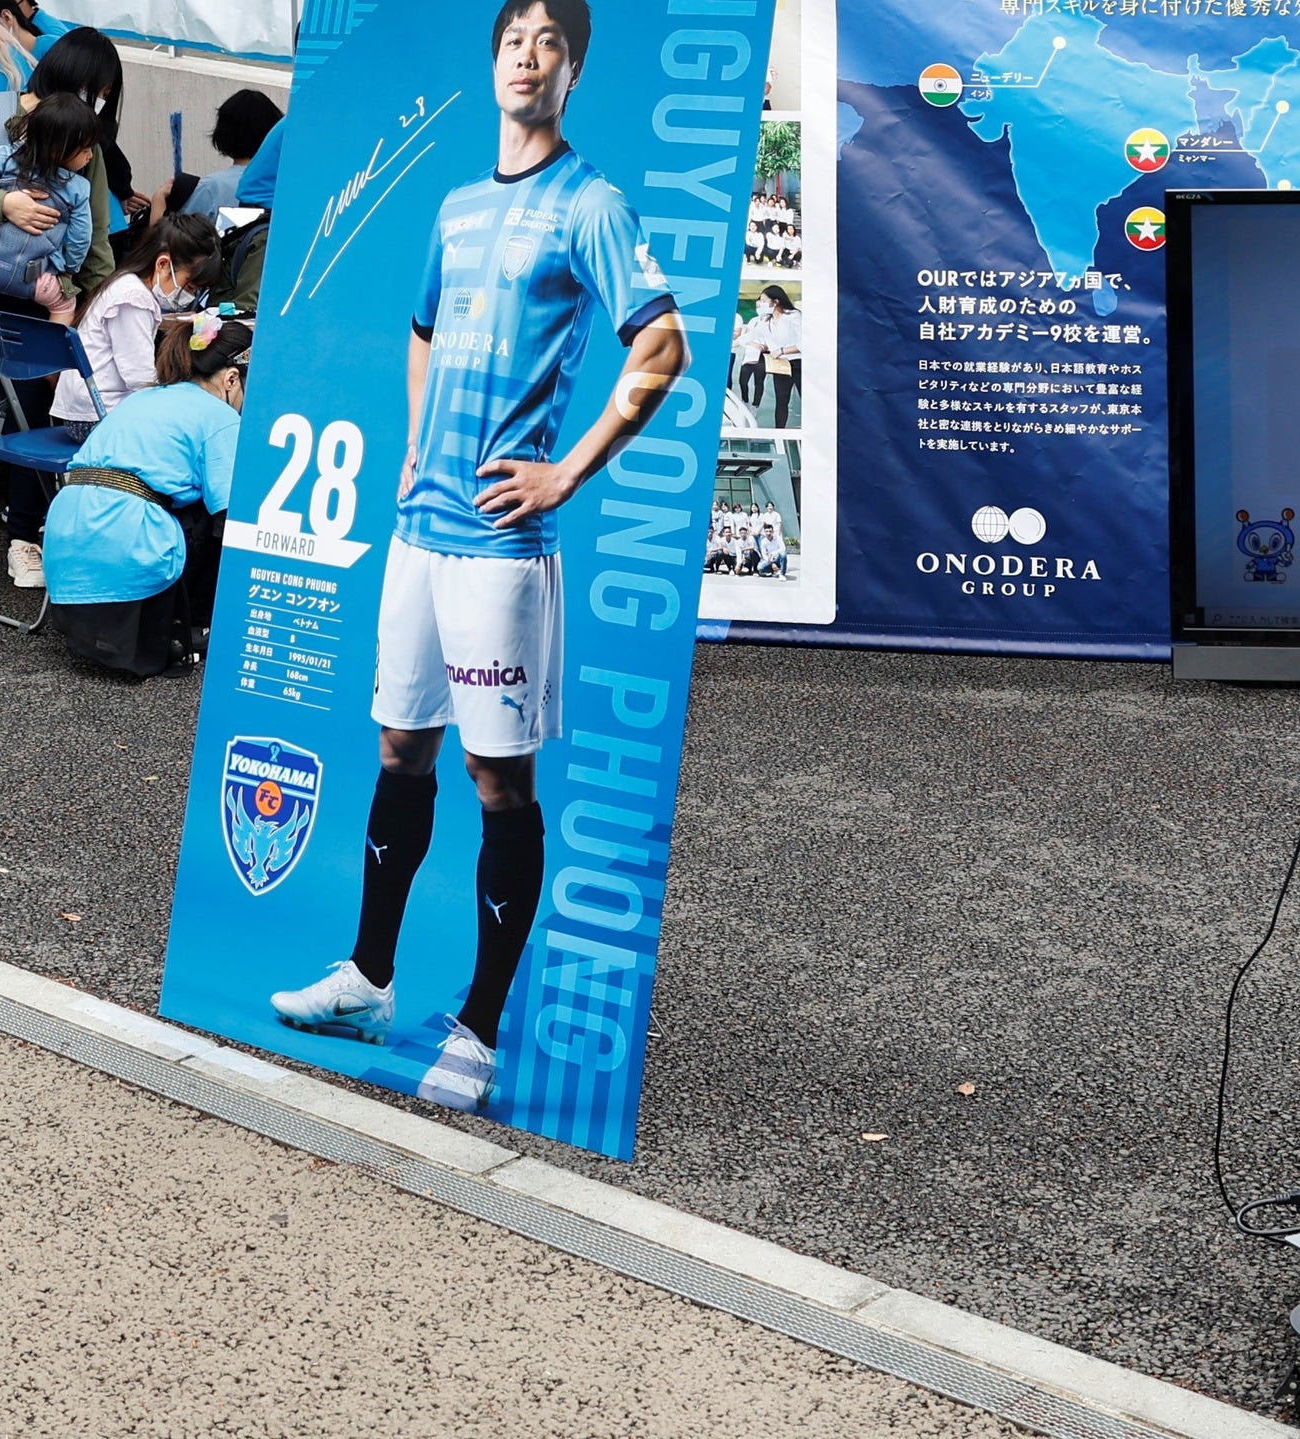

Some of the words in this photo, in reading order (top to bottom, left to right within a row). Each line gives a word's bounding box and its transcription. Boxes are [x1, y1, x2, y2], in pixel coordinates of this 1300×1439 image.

[970, 71, 1034, 85] ニューデリー
[1178, 135, 1234, 149] マンダレー
[1178, 154, 1216, 162] ミャンマー
[917, 296, 1076, 316] 人財育成のための
[919, 322, 1152, 345] 自社アカデミー9校を運営。
[918, 438, 1015, 453] トを実施しています。
[257, 413, 364, 540] 28
[255, 530, 315, 557] FORWARD
[916, 552, 1101, 580] ONODERA
[250, 567, 281, 586] NGUYEN
[283, 573, 303, 588] CONG
[305, 578, 337, 594] PHUONG
[961, 581, 1056, 597] GROUP
[249, 583, 282, 602] グエン
[229, 753, 316, 790] YOKOHAMA
